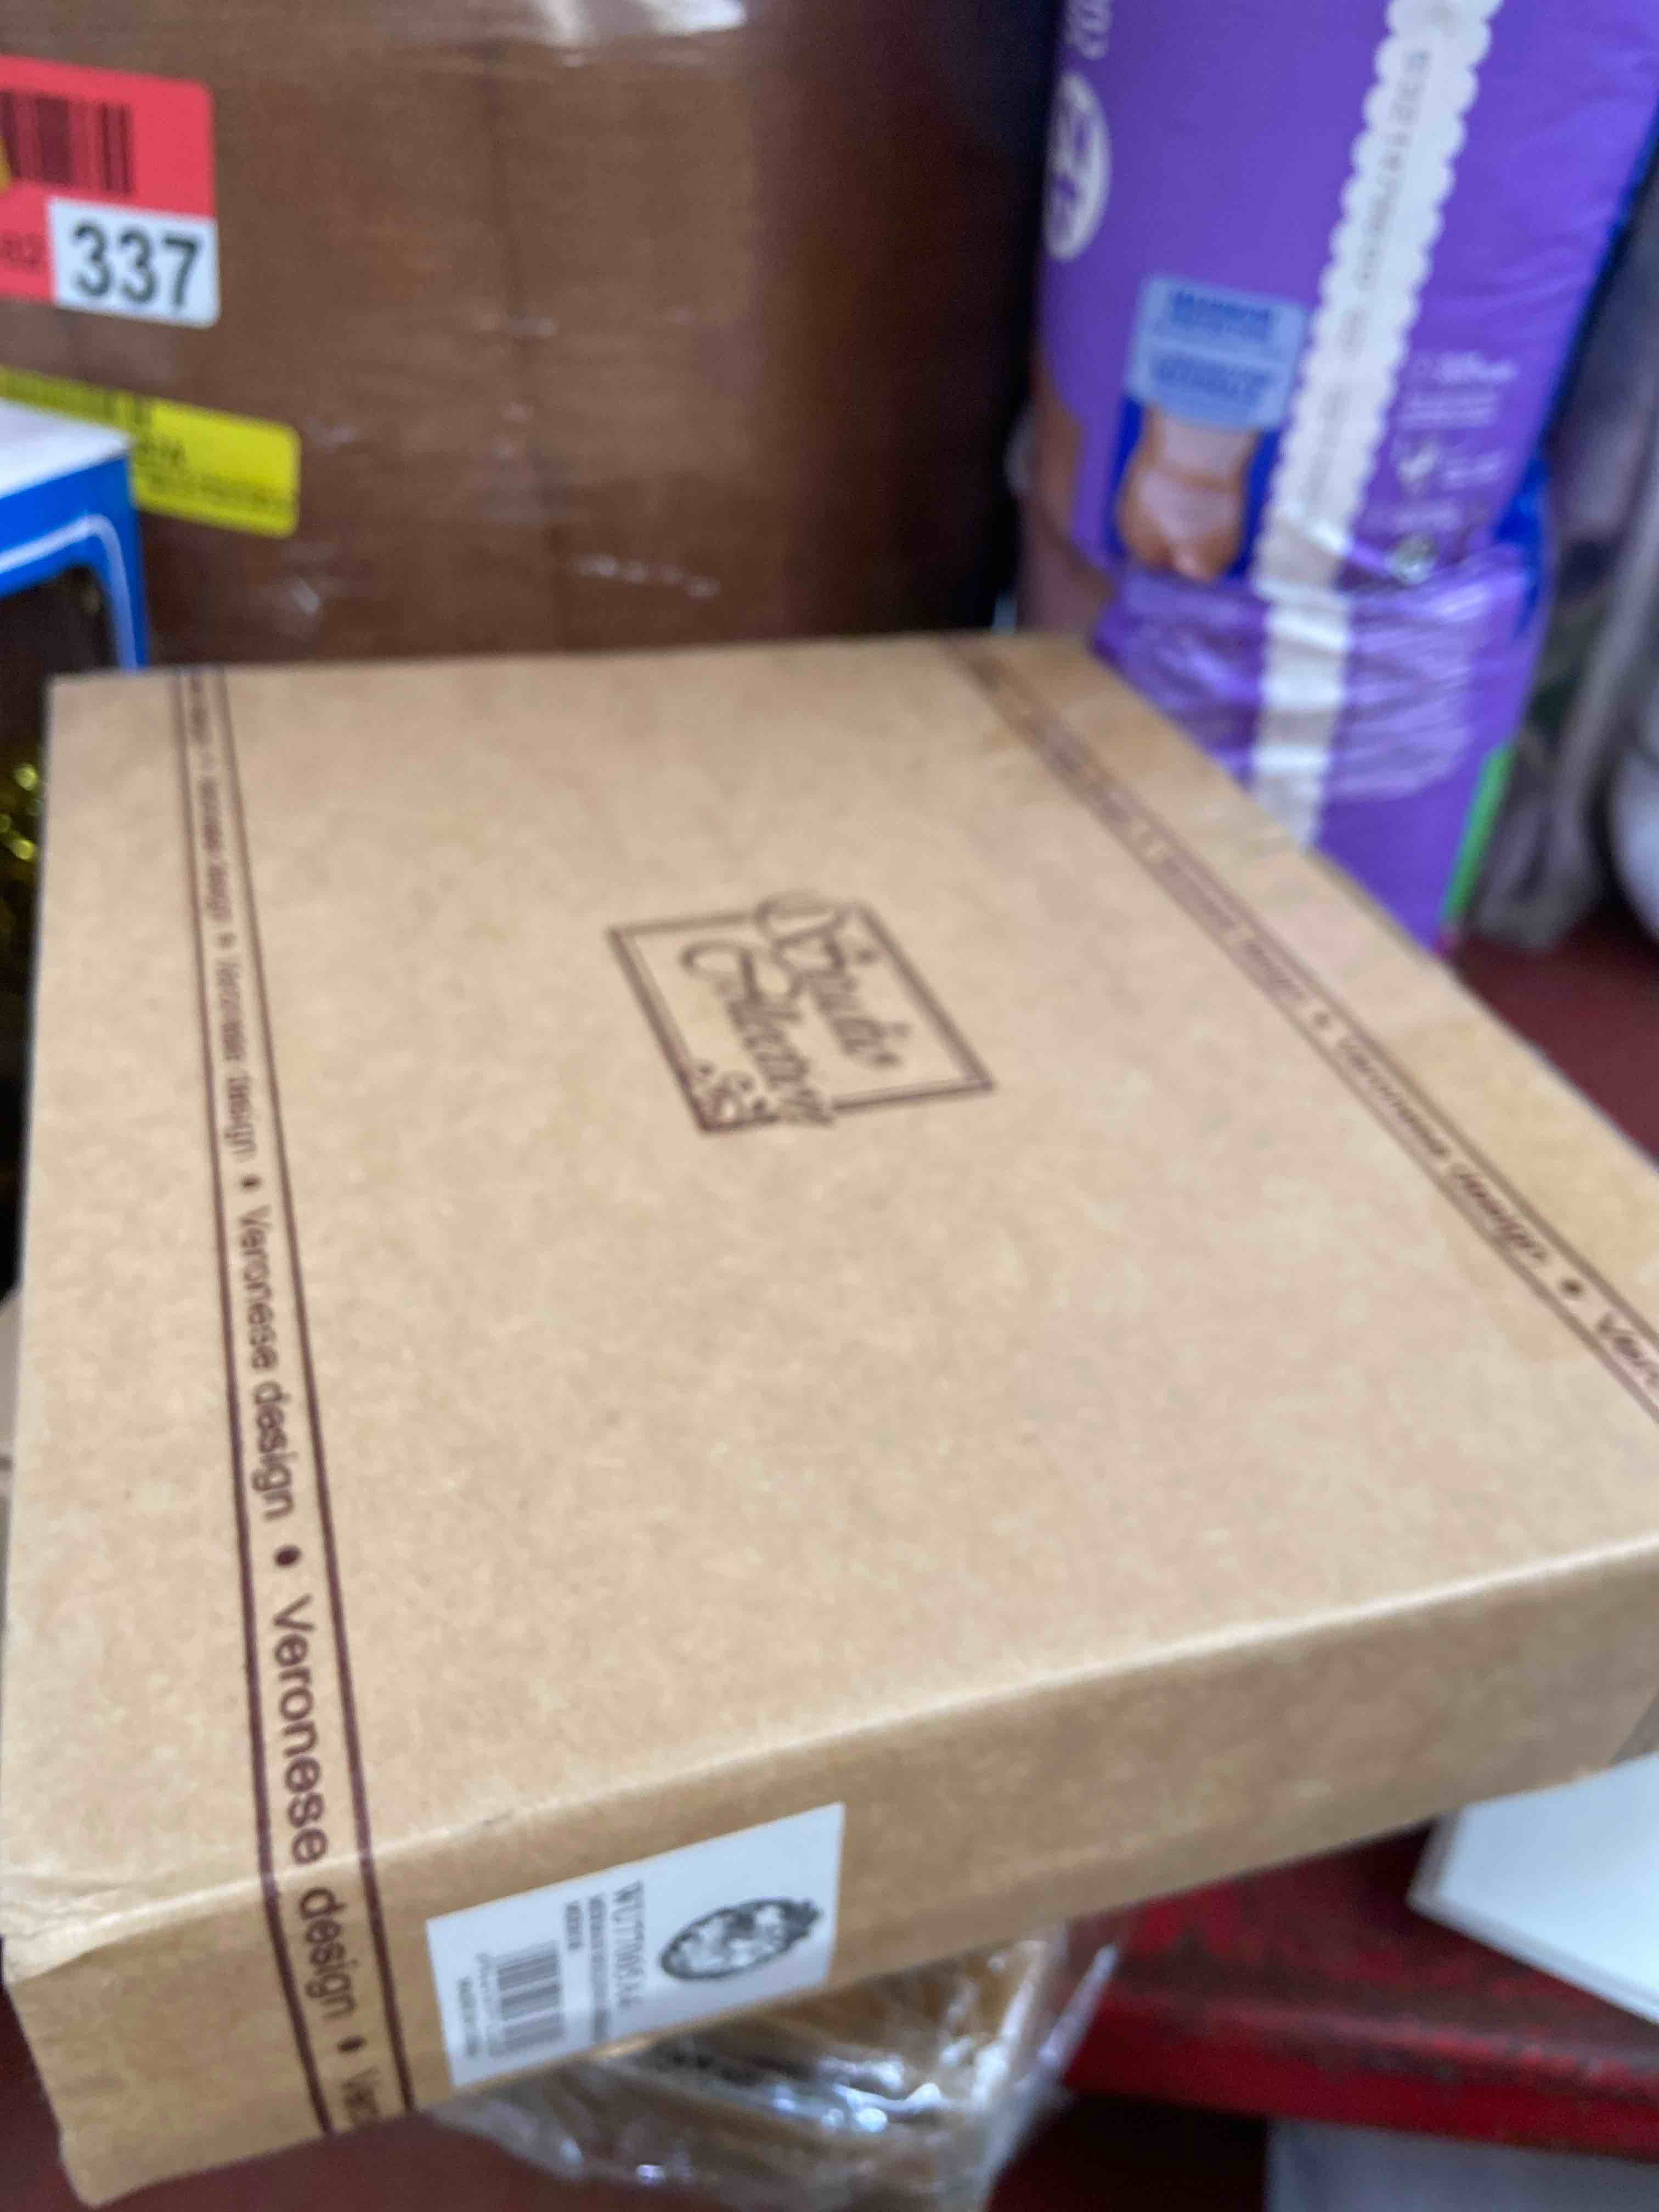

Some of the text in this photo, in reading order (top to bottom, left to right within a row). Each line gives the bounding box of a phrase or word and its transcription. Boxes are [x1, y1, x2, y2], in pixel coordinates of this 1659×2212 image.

[71, 221, 199, 307] 337
[239, 1204, 280, 1370] Veronese
[251, 1380, 300, 1522] design
[273, 1594, 329, 1866] Veronese
[298, 1886, 360, 2021] design
